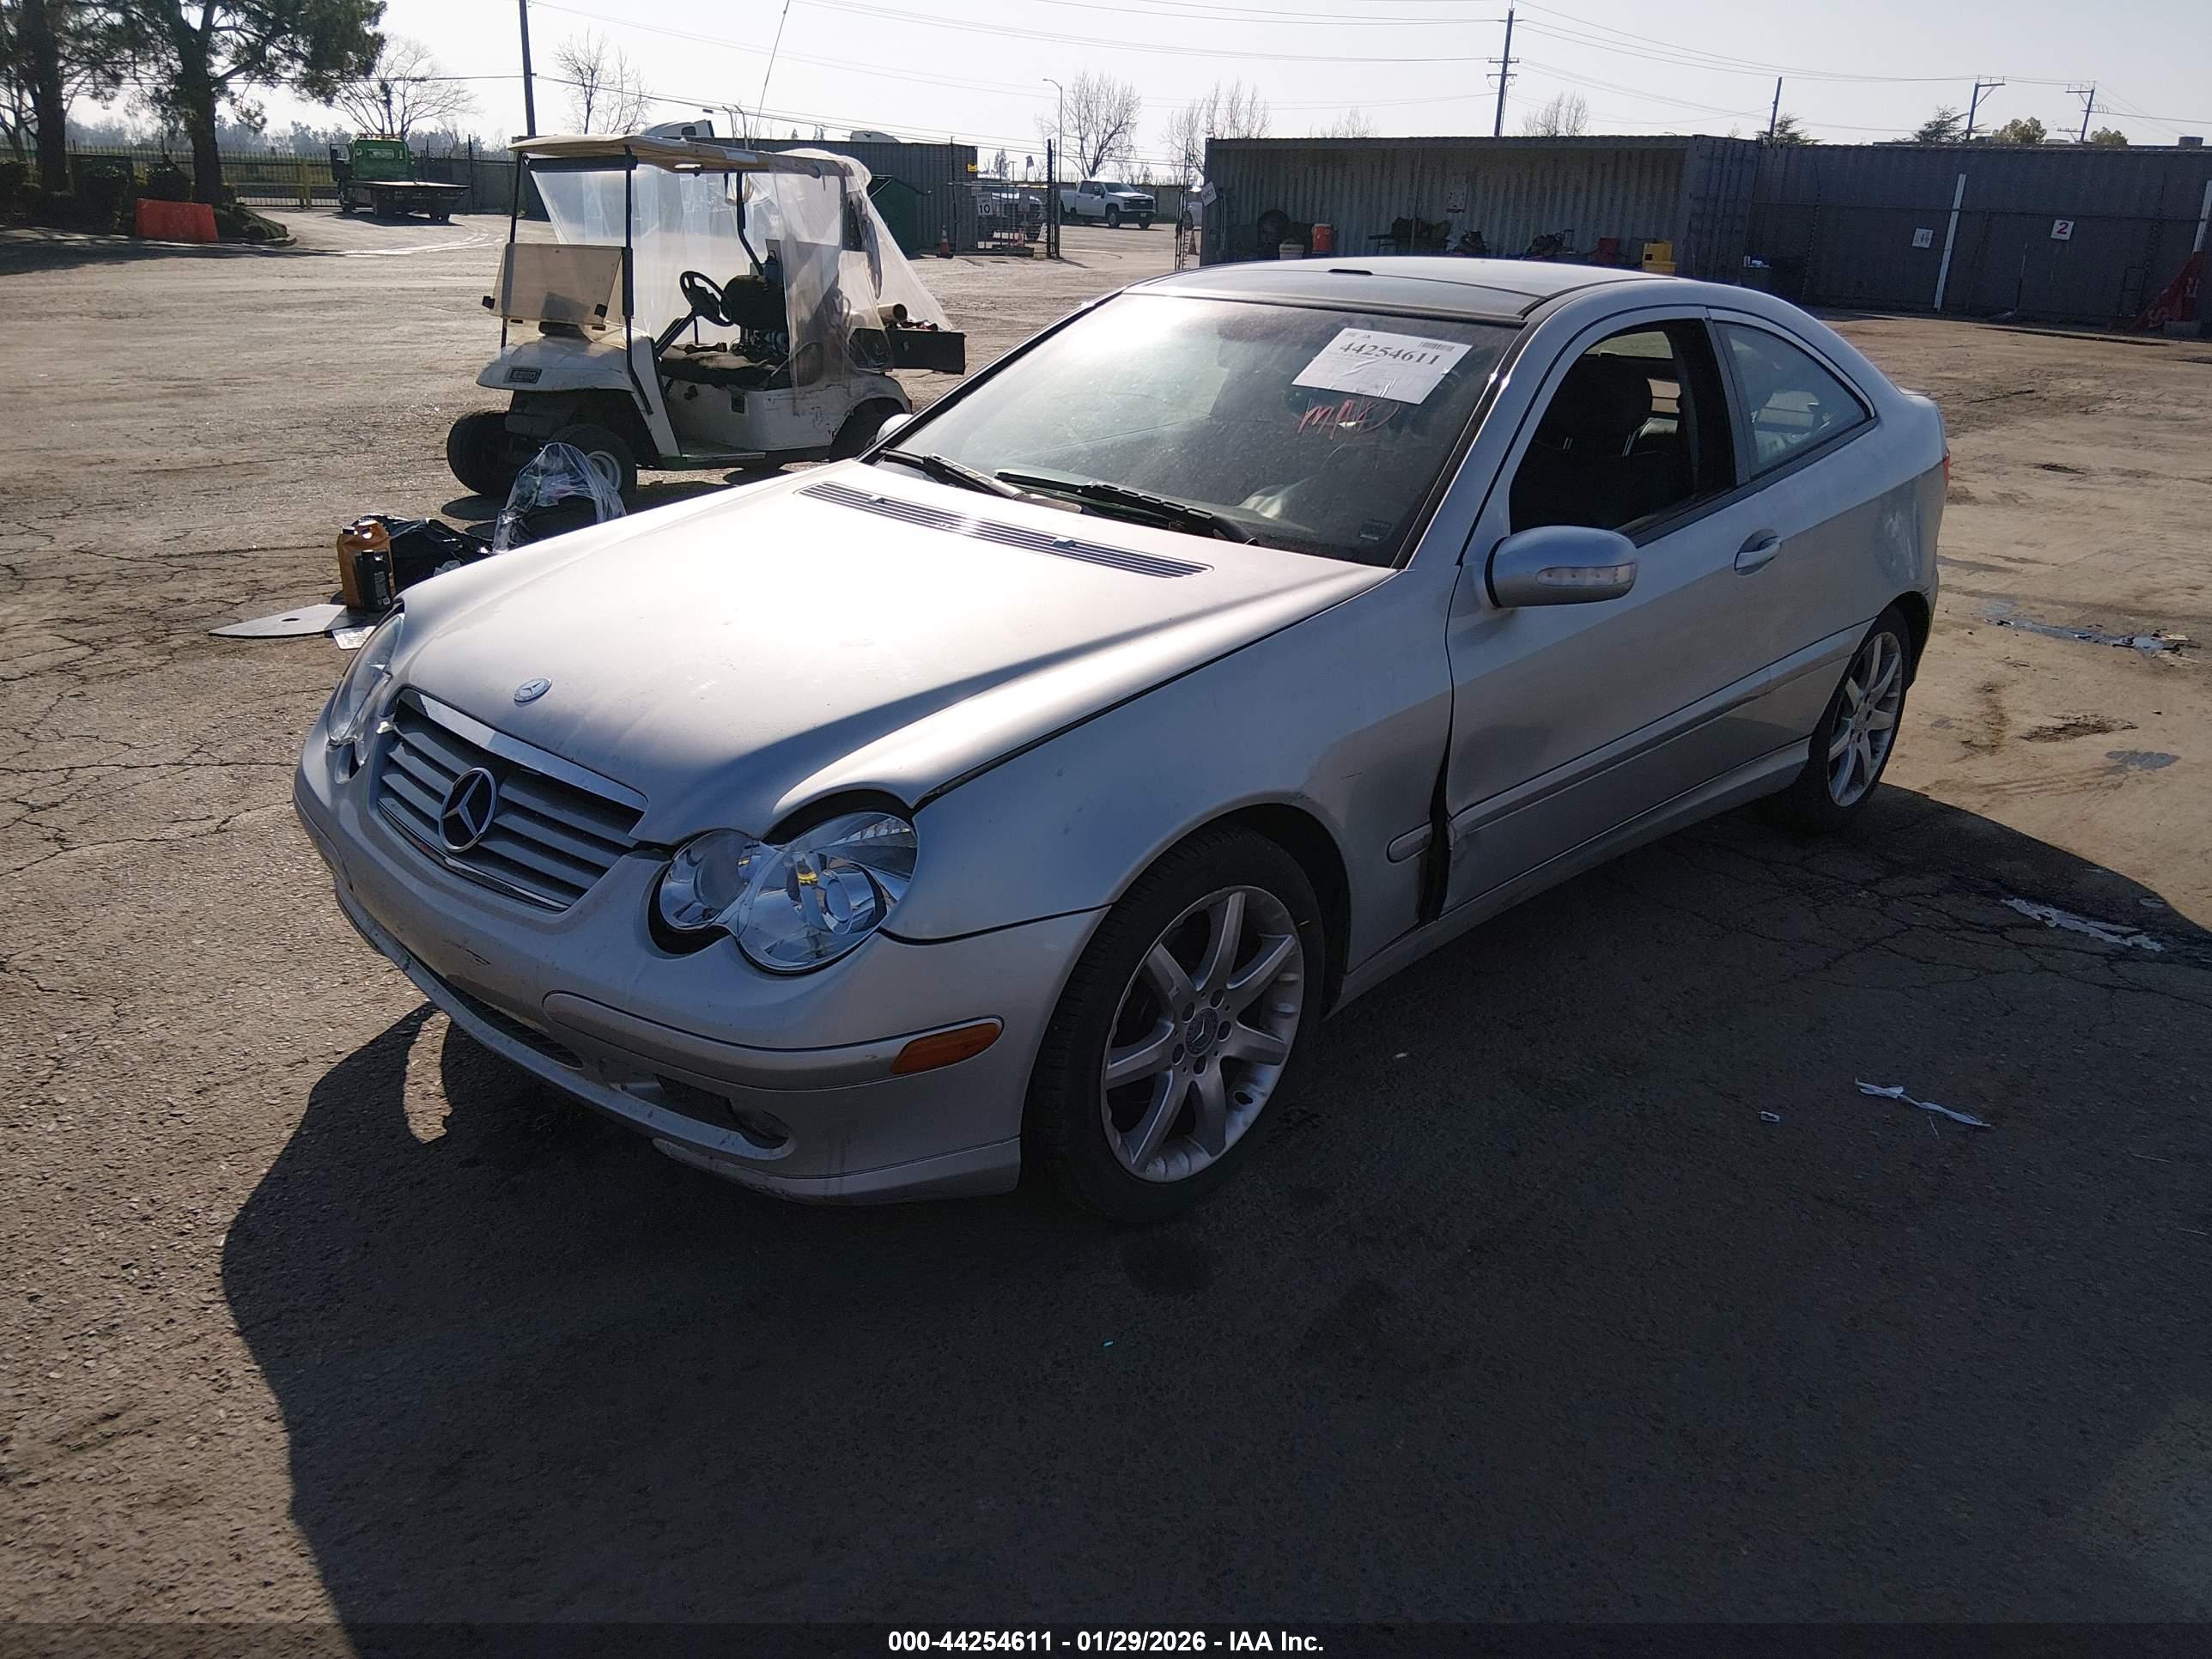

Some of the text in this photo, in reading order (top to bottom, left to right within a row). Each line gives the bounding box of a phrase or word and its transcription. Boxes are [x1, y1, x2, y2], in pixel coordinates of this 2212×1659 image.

[979, 204, 991, 213] 10
[2057, 222, 2069, 234] 2
[1340, 343, 1442, 365] 44254611
